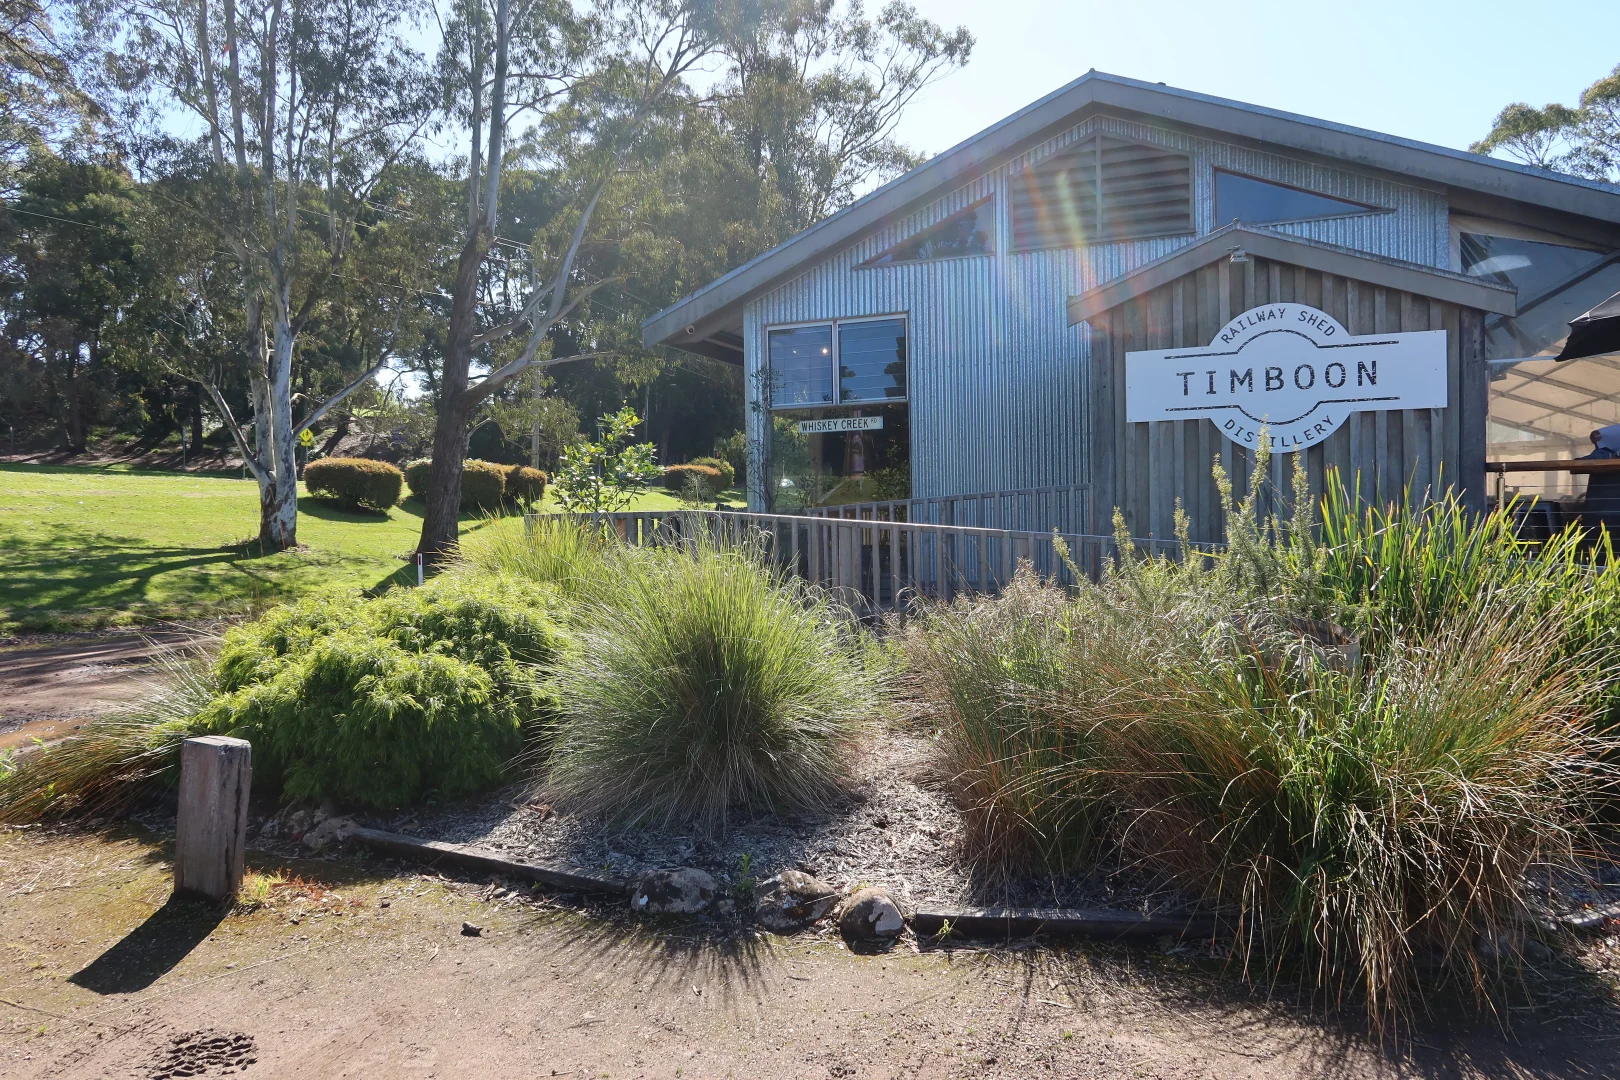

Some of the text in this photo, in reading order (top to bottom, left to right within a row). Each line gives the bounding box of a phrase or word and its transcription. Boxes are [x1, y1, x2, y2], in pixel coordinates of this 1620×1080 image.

[1220, 307, 1336, 344] RAILWAY SHED
[1175, 360, 1378, 397] TIMBOON
[801, 420, 838, 432] WHISKEY
[841, 418, 869, 429] CREEK
[1224, 415, 1334, 448] DISILLERY
